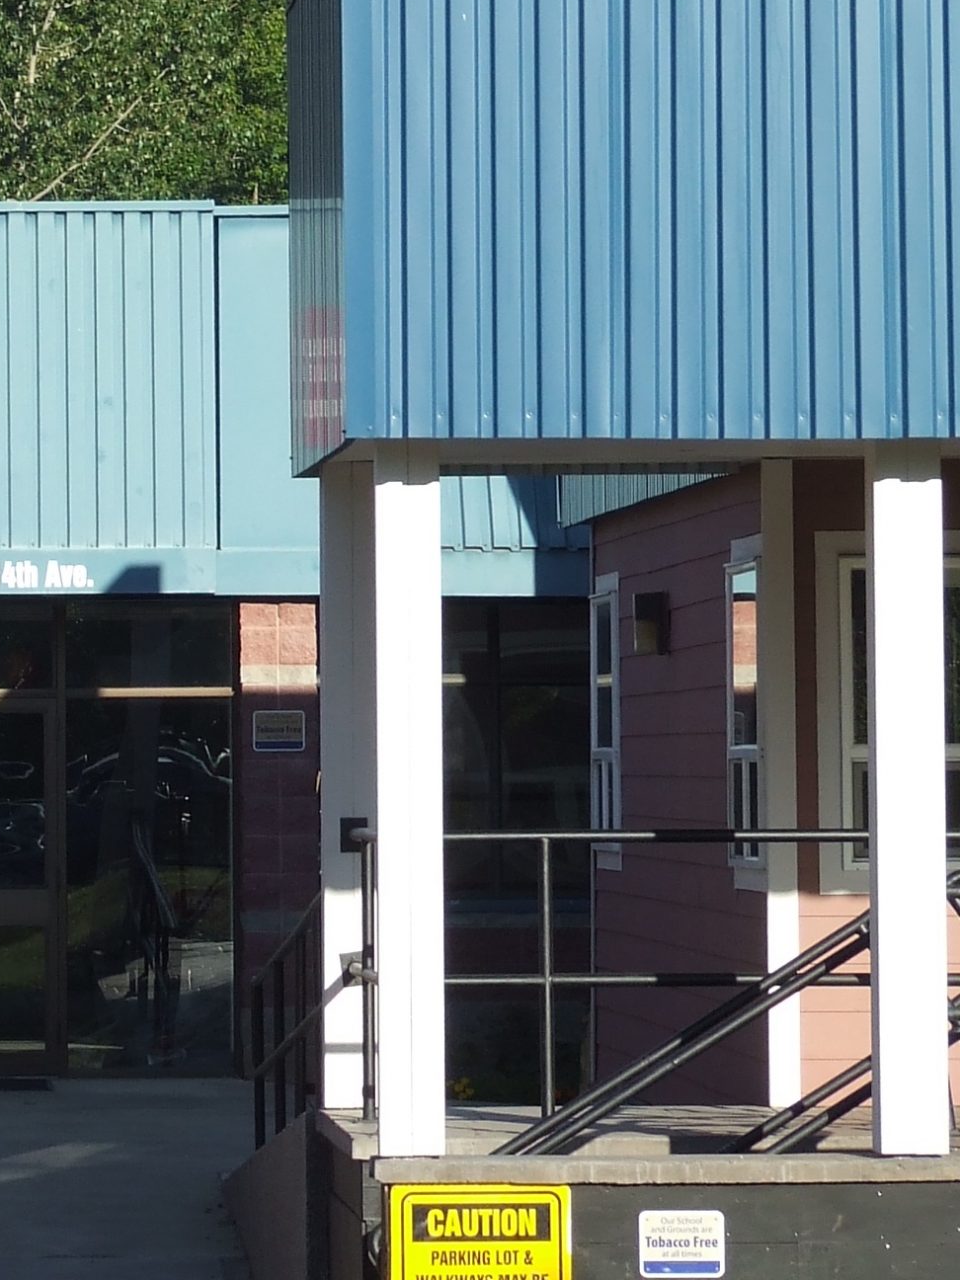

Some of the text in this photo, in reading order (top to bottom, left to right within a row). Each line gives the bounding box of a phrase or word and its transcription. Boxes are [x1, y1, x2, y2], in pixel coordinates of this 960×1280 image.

[43, 560, 94, 588] Ave.
[427, 1208, 537, 1237] CAUTION
[645, 1236, 718, 1248] Tobacco Free
[431, 1250, 533, 1266] PARKING LOT &
